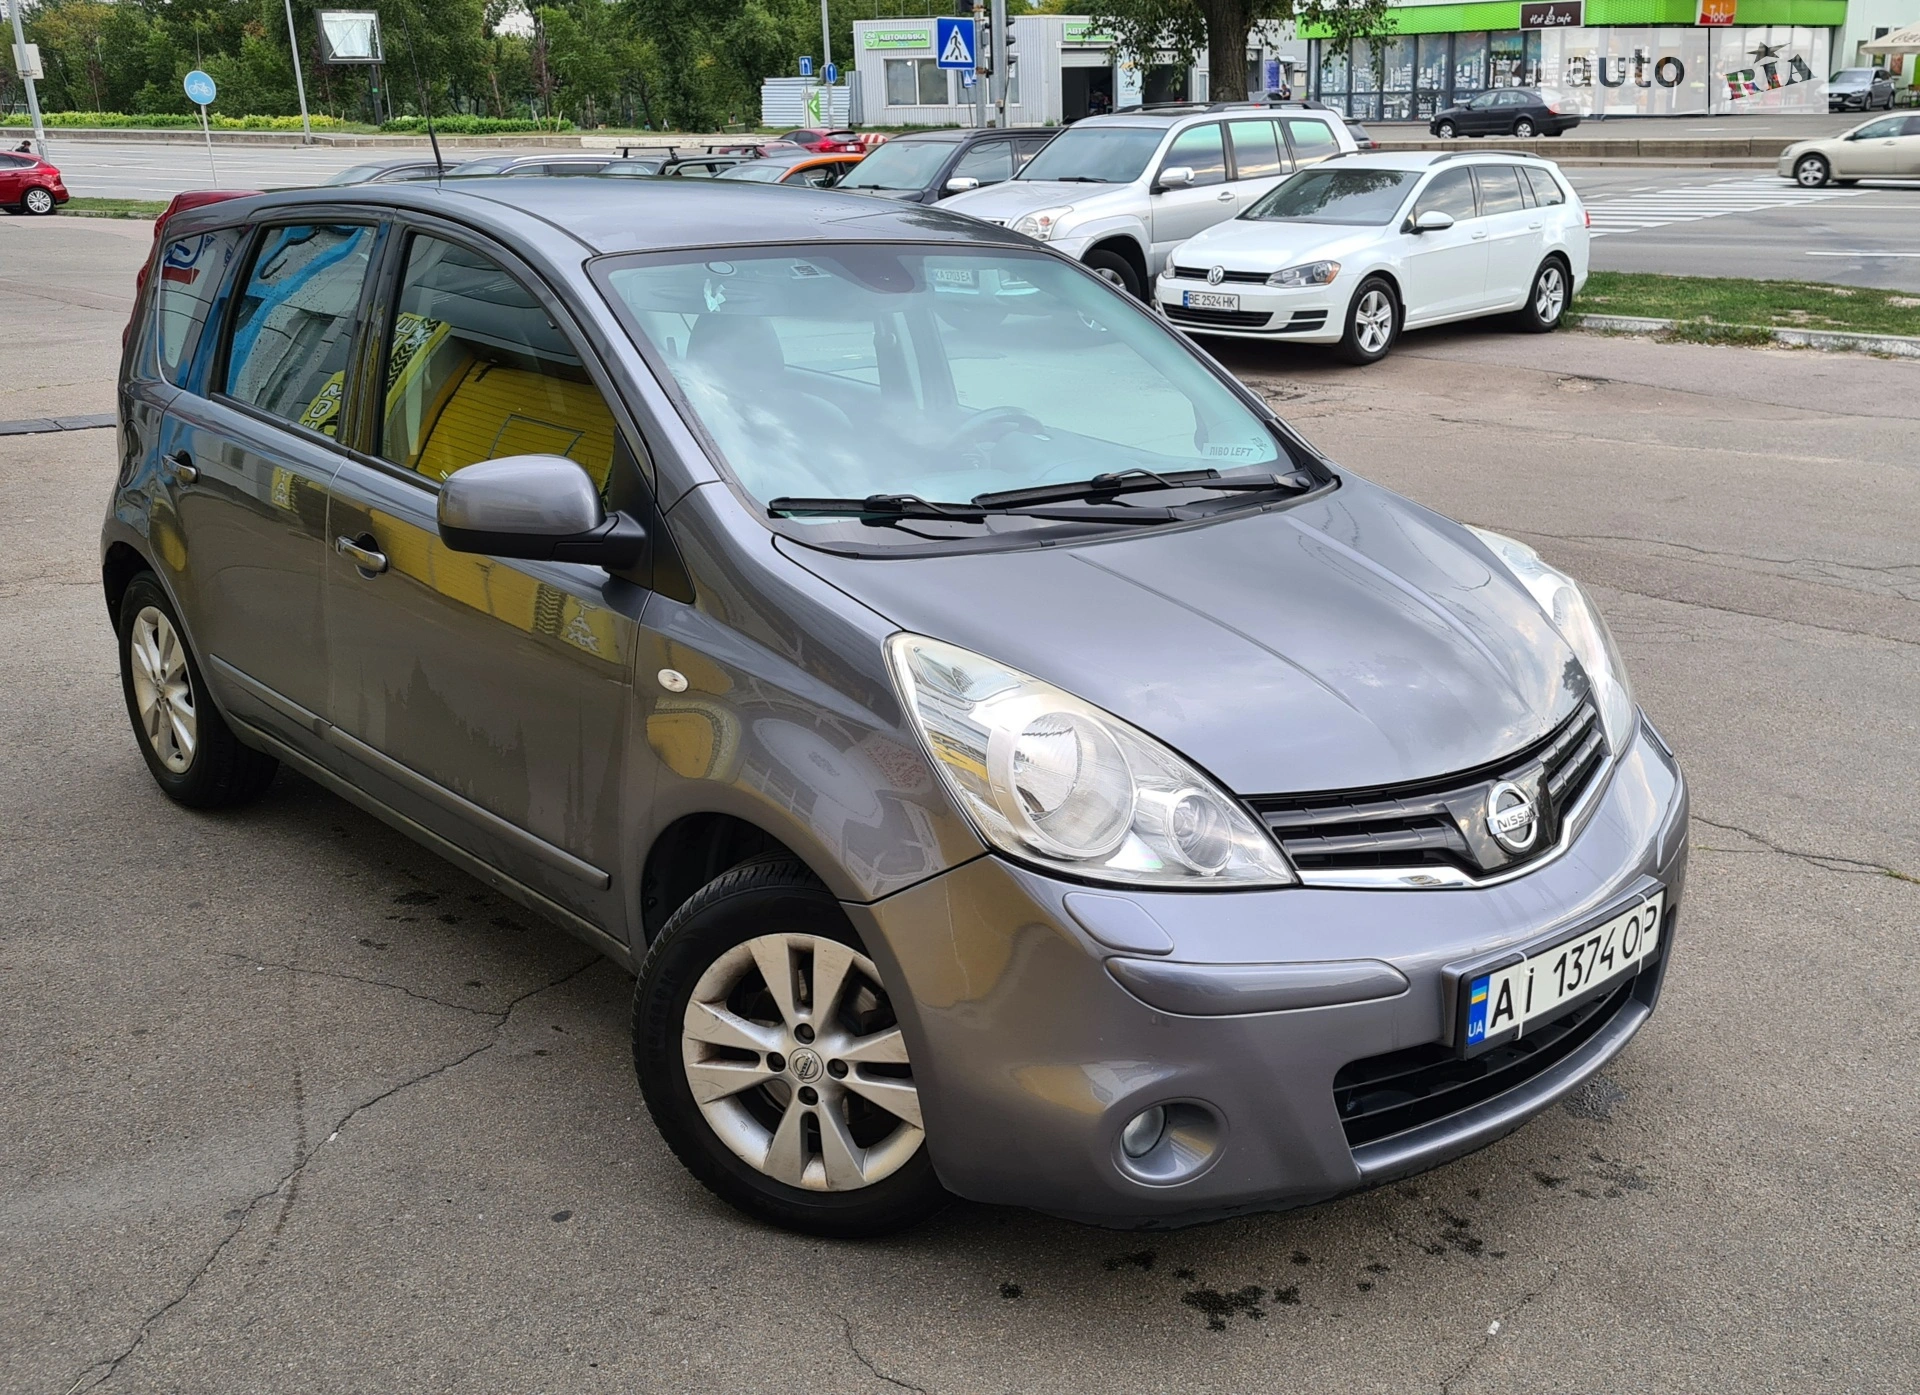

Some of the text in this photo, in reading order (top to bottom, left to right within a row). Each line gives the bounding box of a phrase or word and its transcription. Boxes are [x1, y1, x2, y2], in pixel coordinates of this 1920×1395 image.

[1202, 295, 1221, 307] 2524
[1222, 296, 1236, 308] HK
[1230, 447, 1253, 457] LEFT
[1496, 804, 1536, 829] NISSAN
[1554, 927, 1616, 998] 1374
[1622, 905, 1657, 959] OP
[1468, 1019, 1483, 1038] UA
